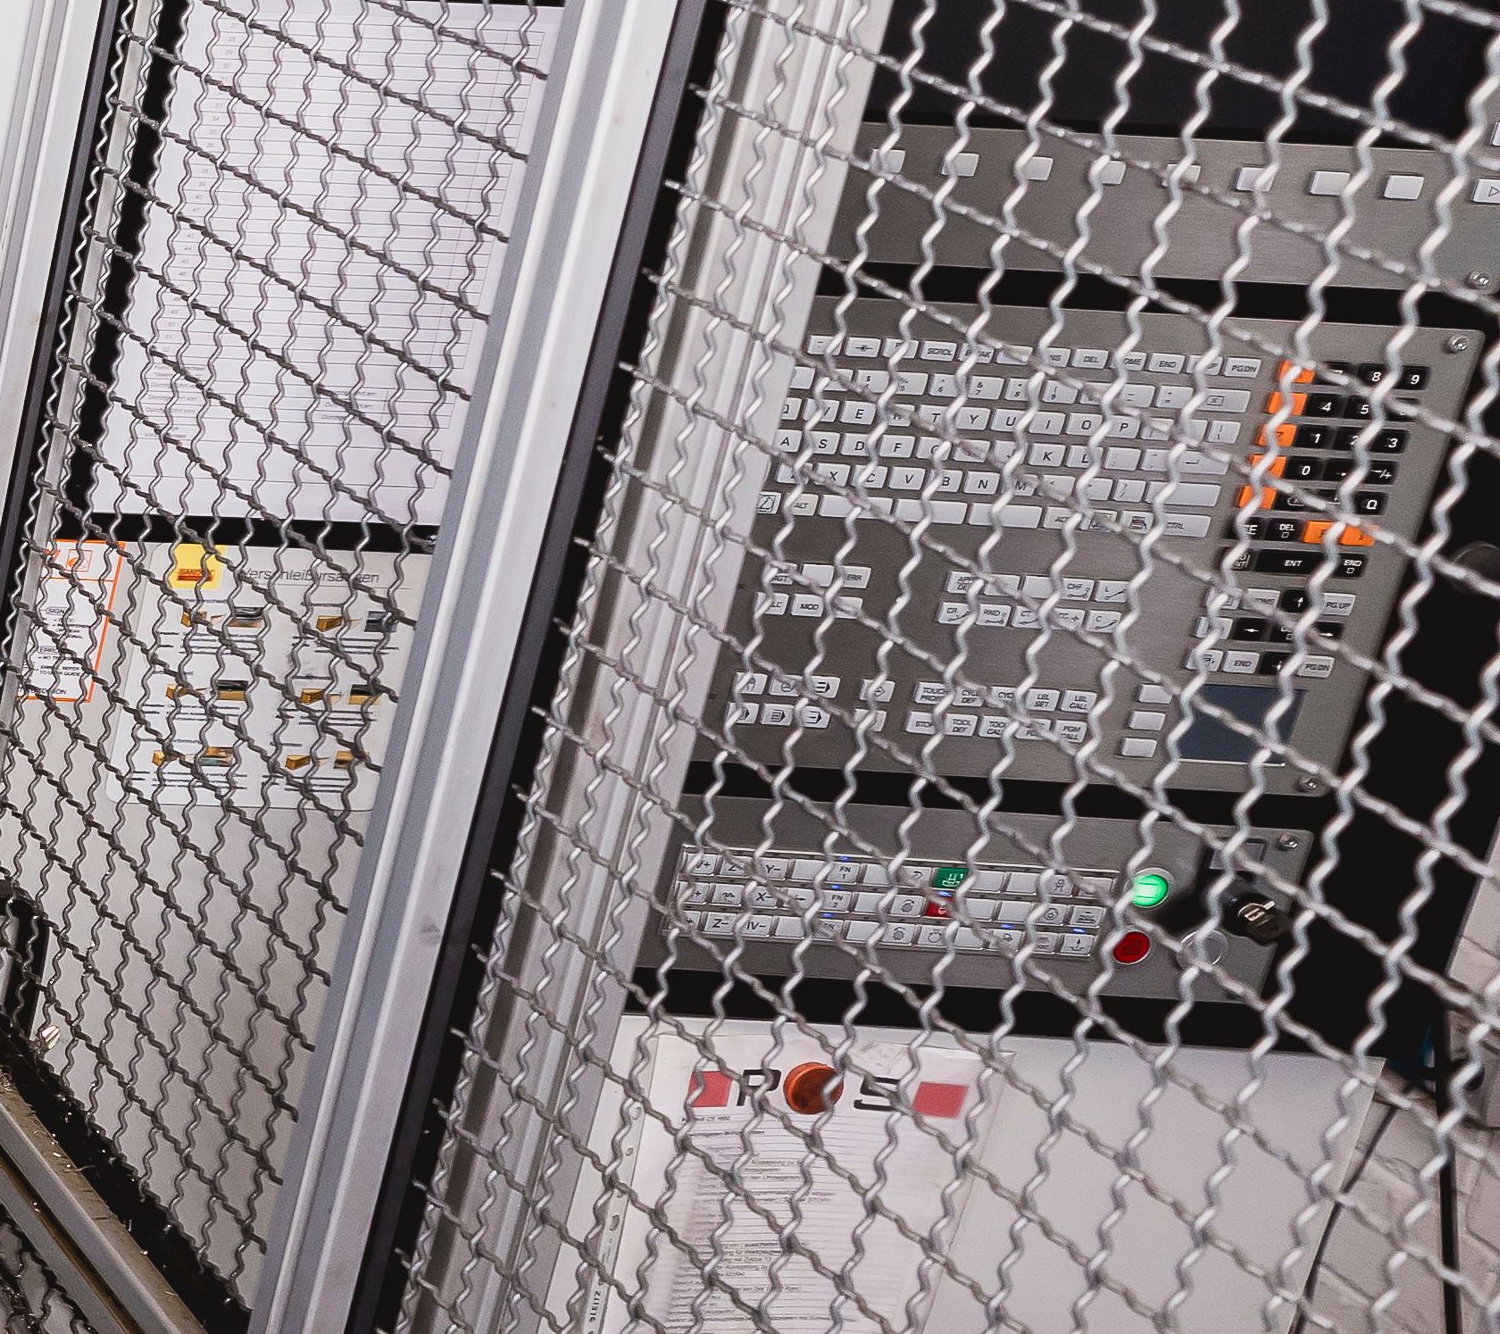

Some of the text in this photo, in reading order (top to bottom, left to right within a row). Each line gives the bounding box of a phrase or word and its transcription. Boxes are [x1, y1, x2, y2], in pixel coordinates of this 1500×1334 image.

[1158, 360, 1177, 368] END
[1372, 371, 1381, 381] 8
[1411, 374, 1420, 385] 9
[1322, 402, 1331, 412] 4
[1360, 404, 1369, 415] 5
[855, 408, 864, 419] E
[932, 413, 941, 423] T
[969, 414, 979, 424] Y
[1006, 417, 1015, 426] U
[1119, 422, 1129, 432] P
[780, 436, 790, 446] A
[818, 438, 827, 448] S
[1314, 433, 1320, 443] 1
[1388, 438, 1398, 448] 3
[854, 440, 865, 451] D
[893, 442, 902, 452] F
[1042, 451, 1052, 461] K
[828, 470, 839, 481] X
[904, 474, 914, 484] V
[978, 479, 989, 489] N
[1279, 523, 1295, 532] DEL
[1285, 559, 1302, 567] ENT
[1344, 559, 1362, 567] END
[952, 718, 972, 726] TOOL
[737, 1069, 900, 1112] PS
